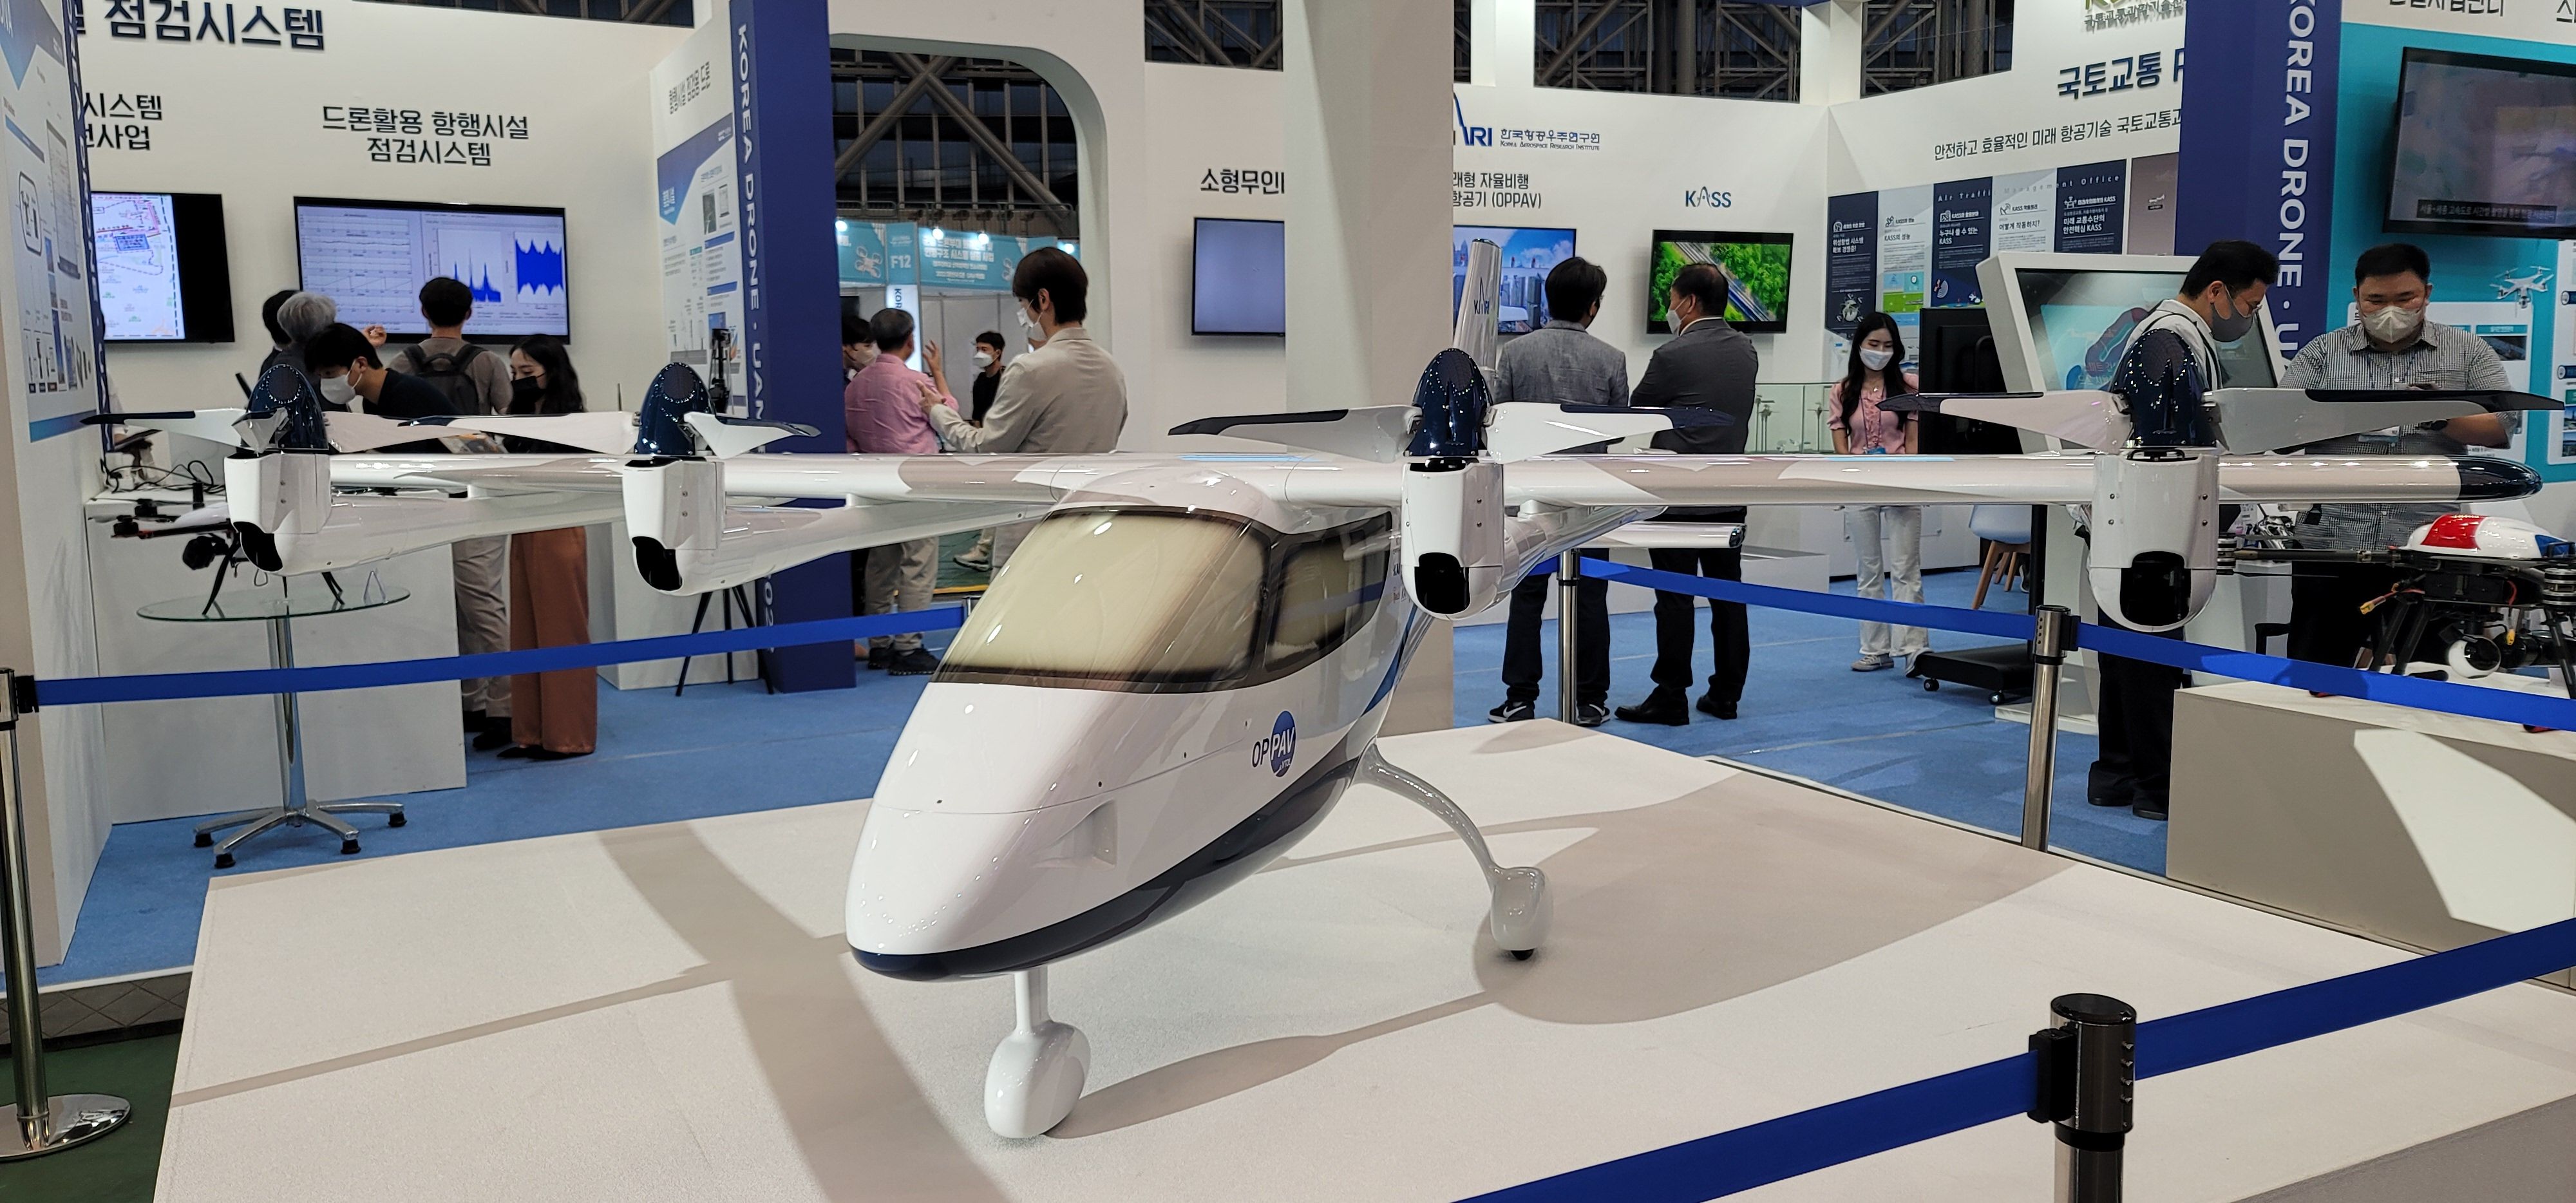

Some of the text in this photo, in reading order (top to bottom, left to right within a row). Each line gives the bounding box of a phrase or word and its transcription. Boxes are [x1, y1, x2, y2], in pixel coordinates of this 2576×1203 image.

[2057, 51, 2162, 100] 국토교통
[323, 106, 529, 140] 드론활용 항행시설
[1501, 128, 1600, 144] 한국항공우주연구원
[1934, 140, 1978, 161] 안전하고
[1982, 132, 2028, 154] 효율적인
[2032, 127, 2057, 144] 미래
[2061, 119, 2112, 143] 항공기술
[367, 137, 491, 166] 점검시스템
[738, 23, 752, 164] KOREA
[745, 173, 759, 310] DRONE
[1200, 168, 1285, 195] 소형무인
[1480, 173, 1530, 190] 자율비행
[2081, 175, 2120, 186] Office
[1492, 192, 1542, 209] (OPPAV)
[1685, 186, 1732, 208] KASS
[2063, 213, 2105, 225] 미래 교통수단의
[2277, 138, 2309, 287] DRONE
[1939, 228, 1955, 237] 누구나
[1961, 227, 1967, 235] 수
[1967, 227, 1979, 235] 있는
[1999, 222, 2015, 231] 어떻게
[2016, 220, 2040, 229] 작동하지?
[2063, 223, 2102, 234] 안전핵심 KASS
[1850, 236, 1864, 245] 시스템
[890, 255, 912, 269] F12
